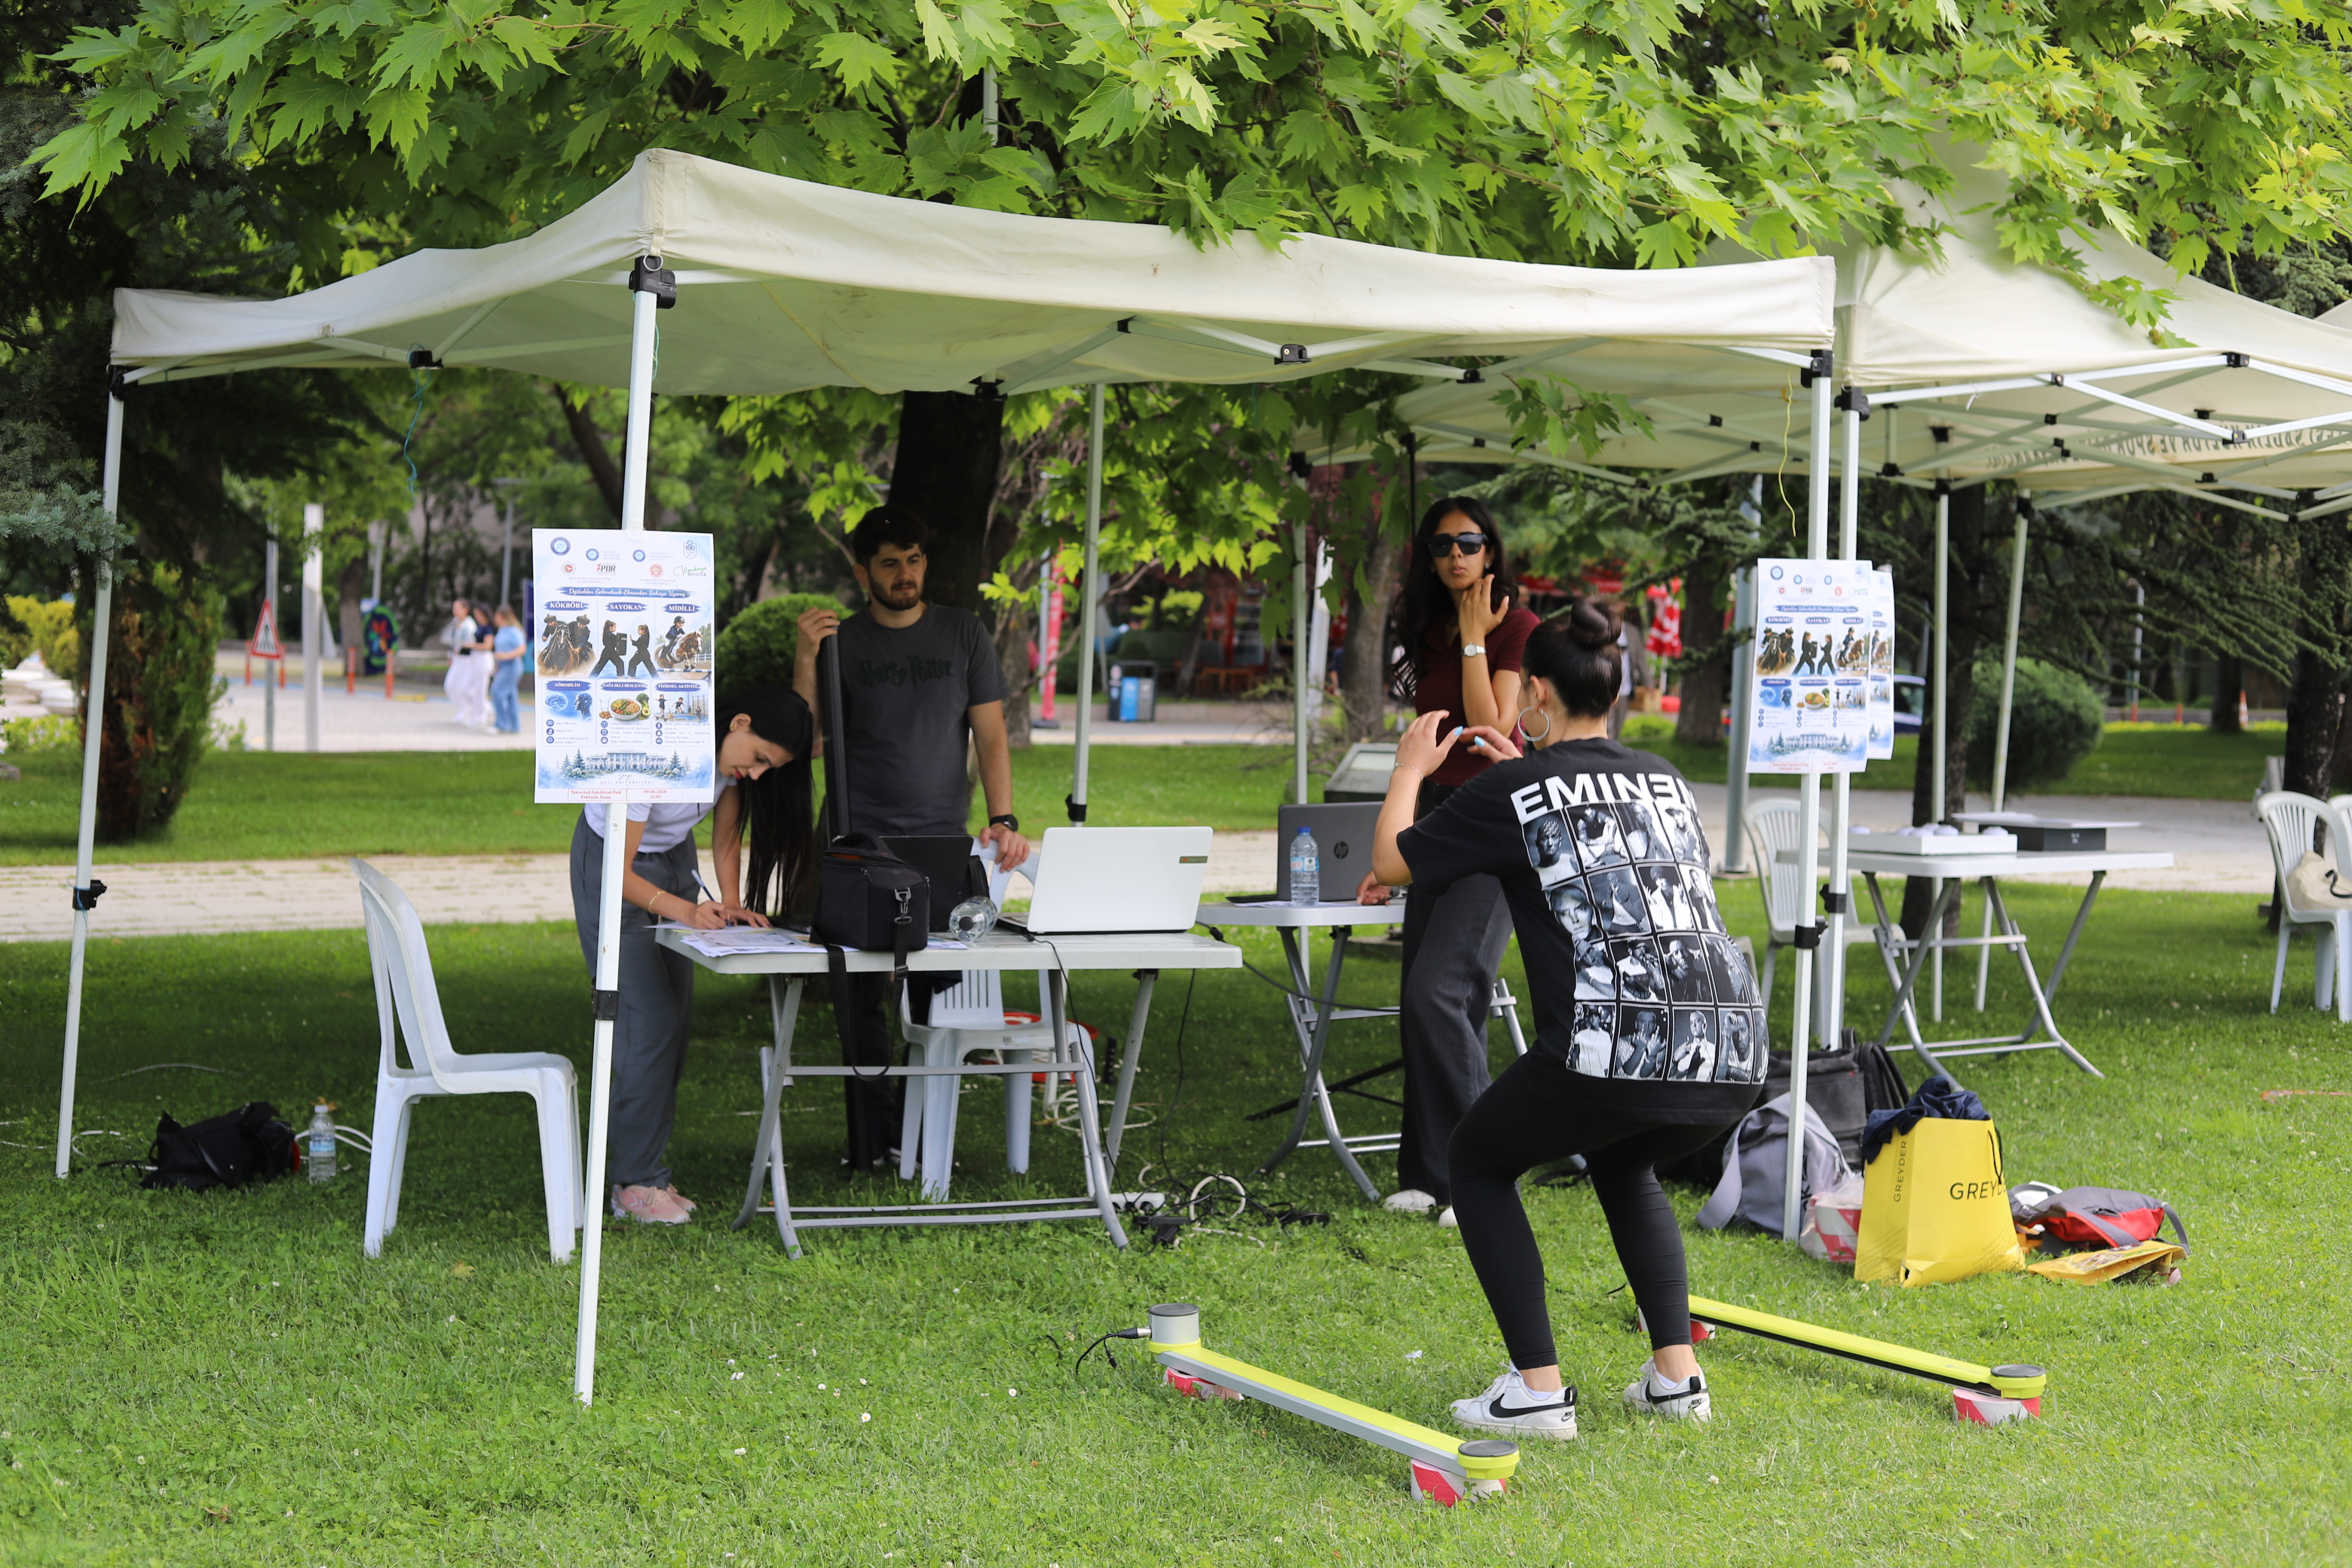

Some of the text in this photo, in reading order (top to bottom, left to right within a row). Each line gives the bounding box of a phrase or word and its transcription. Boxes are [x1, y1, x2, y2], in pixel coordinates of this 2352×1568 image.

[596, 563, 616, 572] SPOR
[856, 654, 955, 691] Harry Potter
[1334, 841, 1348, 859] hp
[1893, 1140, 1908, 1202] GREYDER
